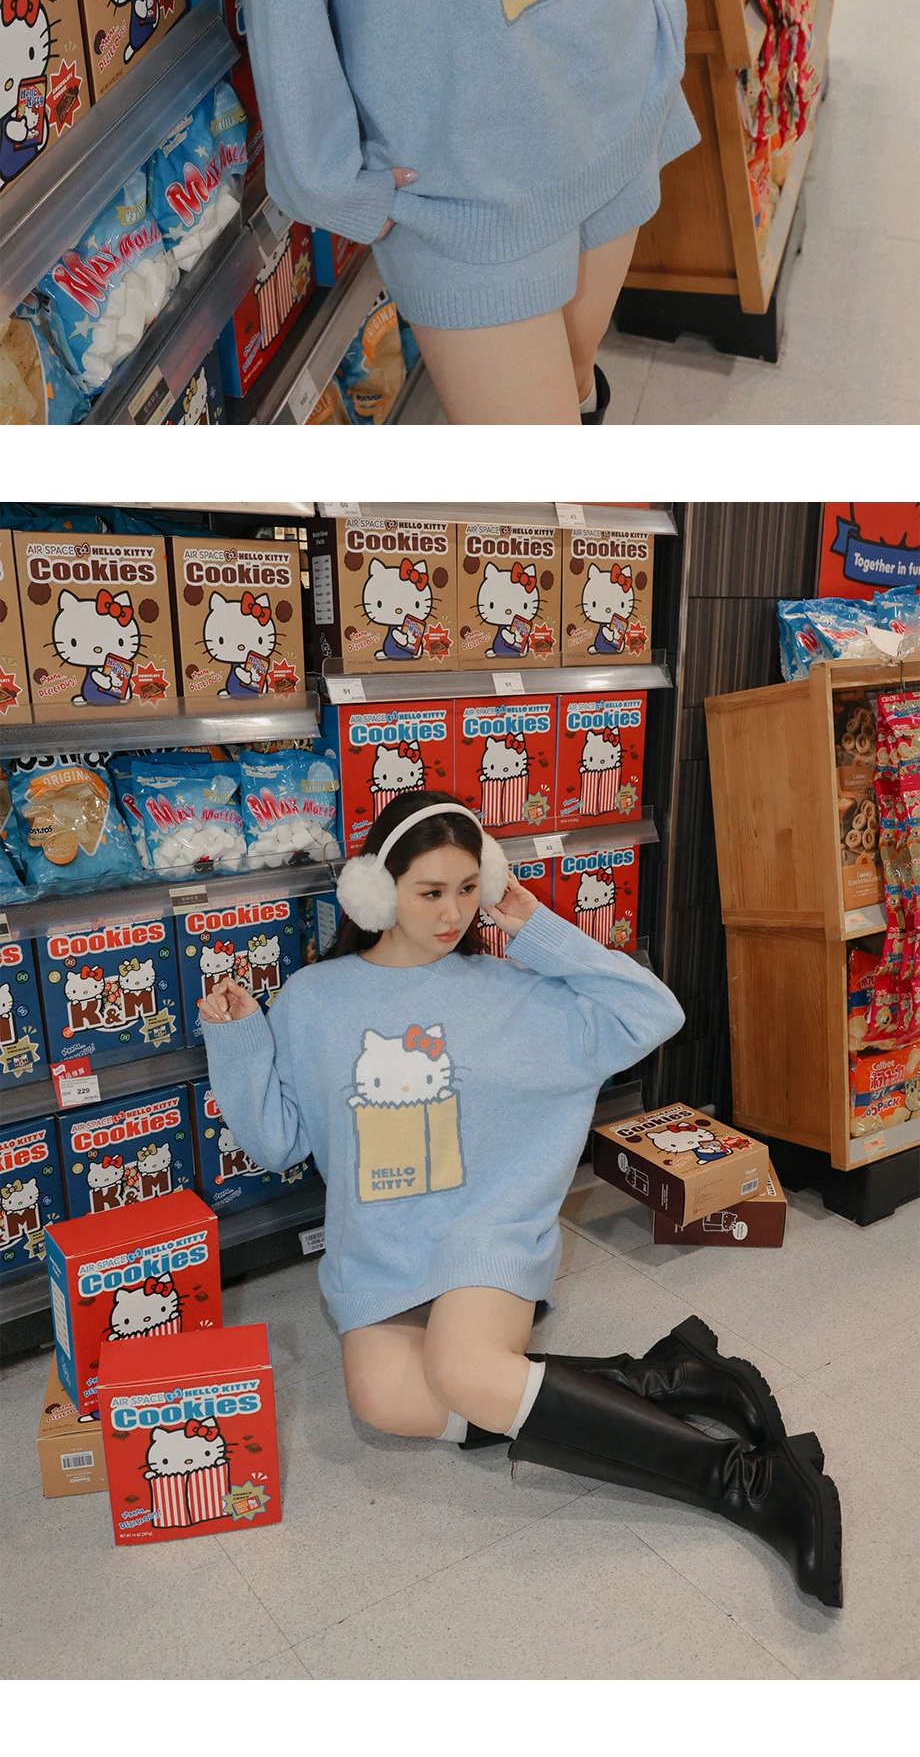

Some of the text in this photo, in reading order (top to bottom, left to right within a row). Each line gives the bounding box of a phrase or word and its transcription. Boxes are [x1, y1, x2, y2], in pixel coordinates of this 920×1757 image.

[28, 545, 153, 557] AIR SPACE HELLO KITTY
[348, 530, 448, 553] Cookies
[29, 558, 155, 582] Cookies
[186, 562, 290, 585] Cookies
[854, 552, 906, 575] Together in
[568, 709, 640, 728] Cookies
[50, 923, 164, 958] Cookies
[872, 1059, 895, 1073] Calbee
[77, 1087, 90, 1096] 229
[372, 1167, 416, 1179] HELLO
[372, 1178, 416, 1190] KITTY
[81, 1246, 208, 1295] Cookies
[112, 1381, 258, 1407] AIR SPACE HELLO KITTY
[114, 1394, 259, 1428] Cookies
